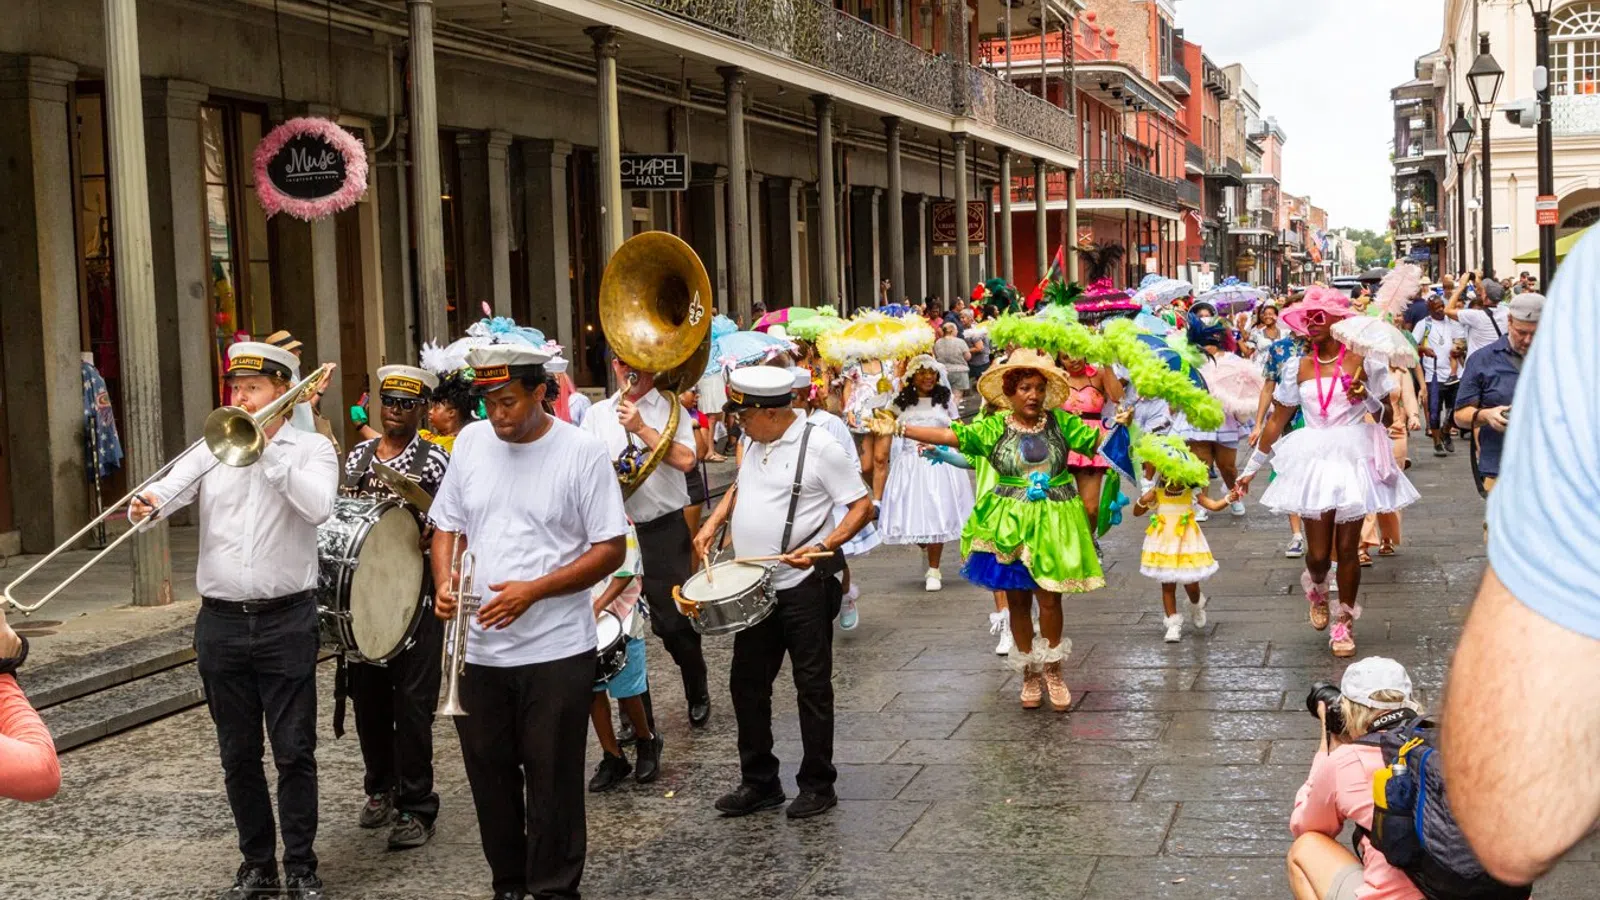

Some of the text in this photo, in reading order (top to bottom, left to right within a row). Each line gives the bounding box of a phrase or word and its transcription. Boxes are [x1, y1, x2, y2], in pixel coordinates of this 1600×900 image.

[285, 147, 336, 173] Muse
[620, 158, 682, 175] CHAPEL
[635, 175, 665, 186] HATS
[1373, 711, 1405, 727] SONY
